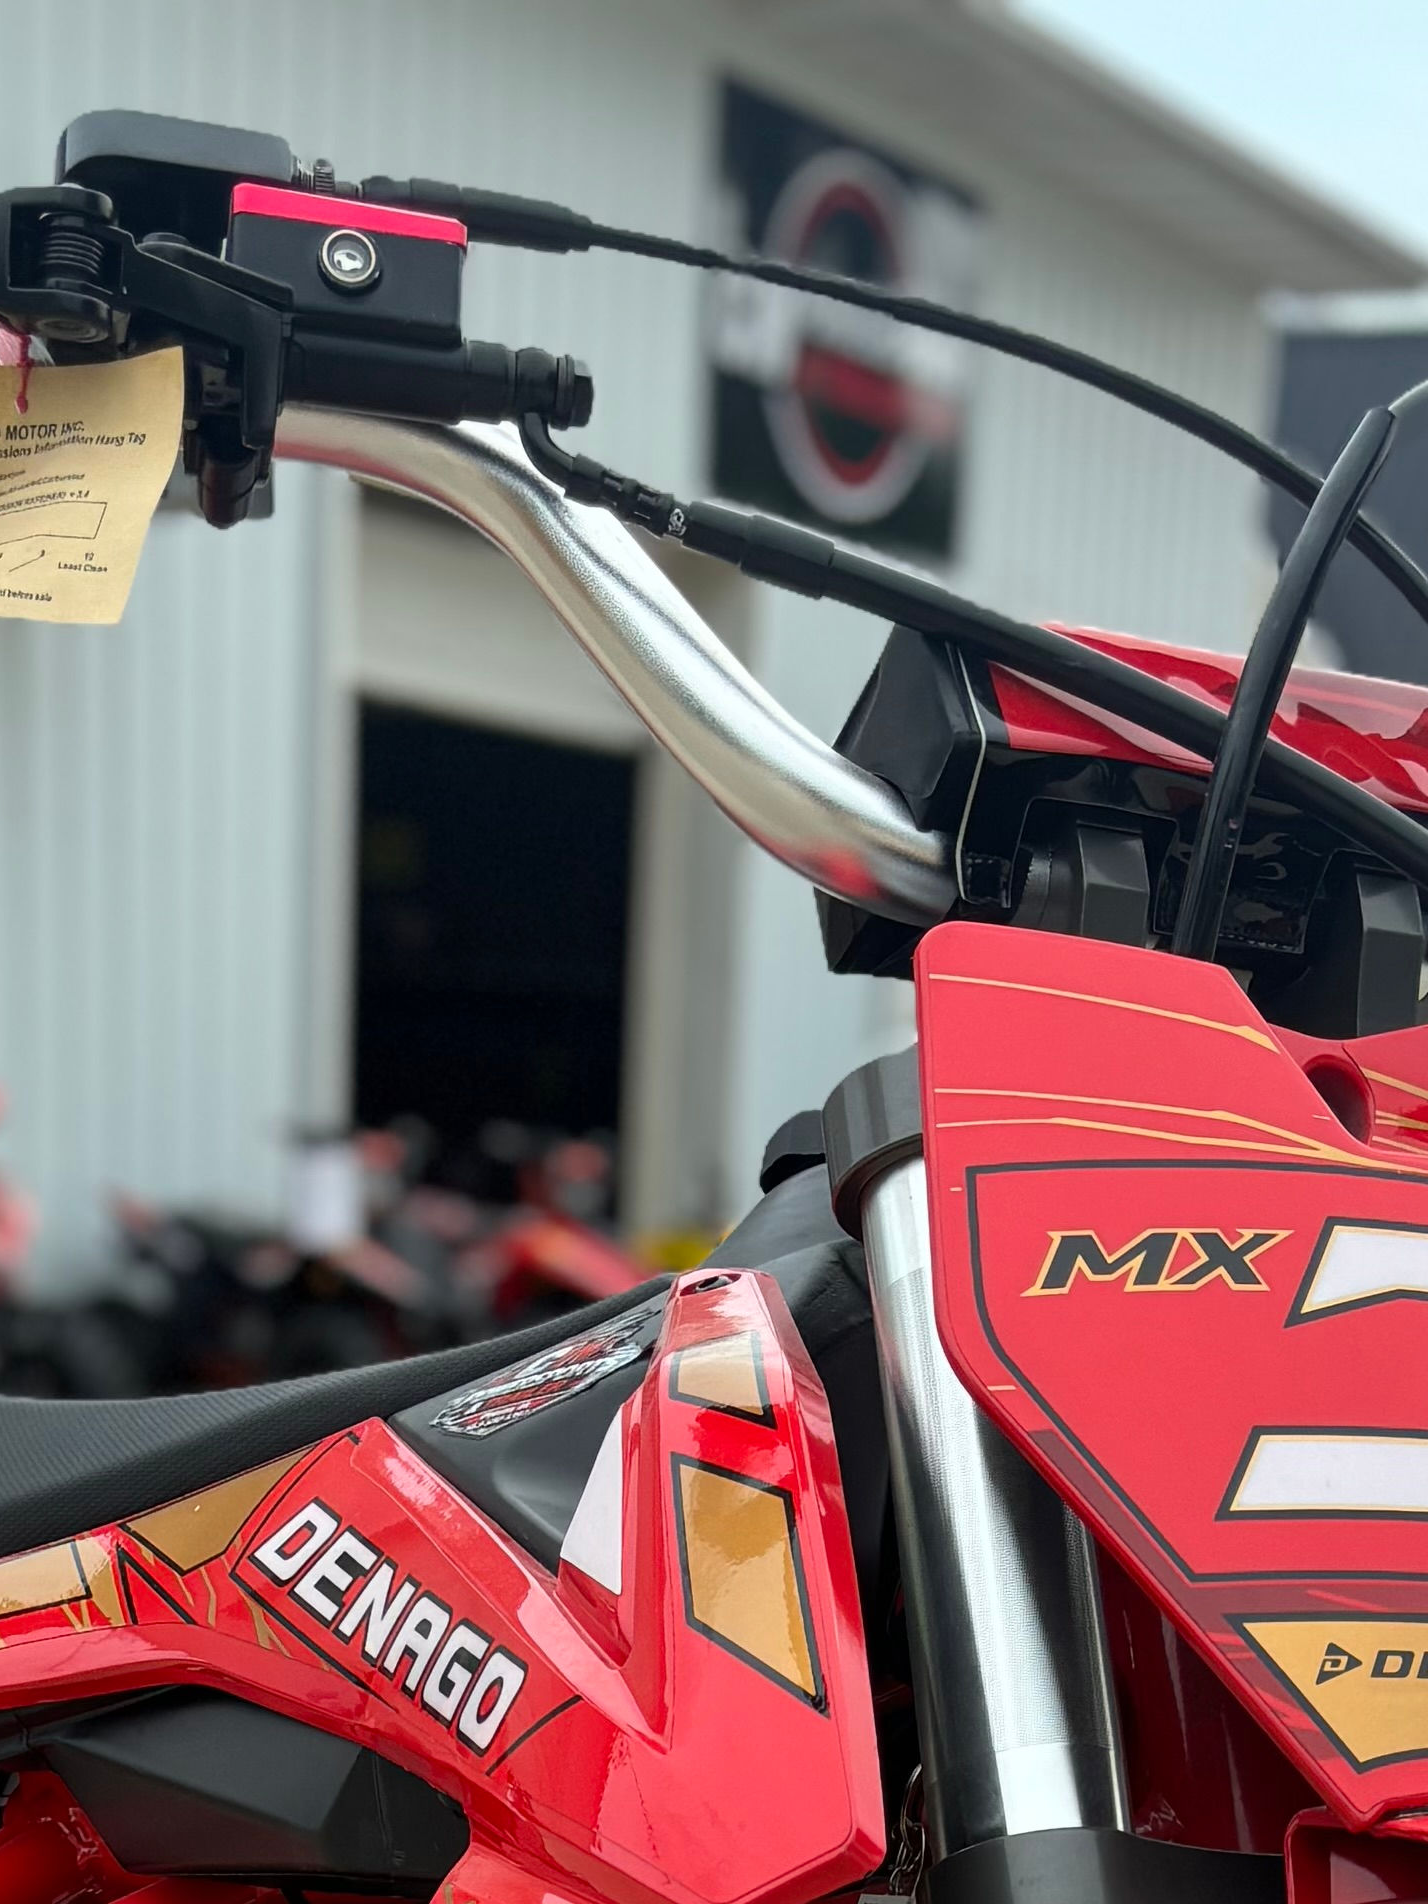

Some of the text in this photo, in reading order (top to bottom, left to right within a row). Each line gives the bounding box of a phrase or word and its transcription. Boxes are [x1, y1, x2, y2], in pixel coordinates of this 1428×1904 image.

[6, 423, 56, 440] MOTOR
[1022, 1229, 1294, 1298] MX
[248, 1497, 528, 1759] DENAGO
